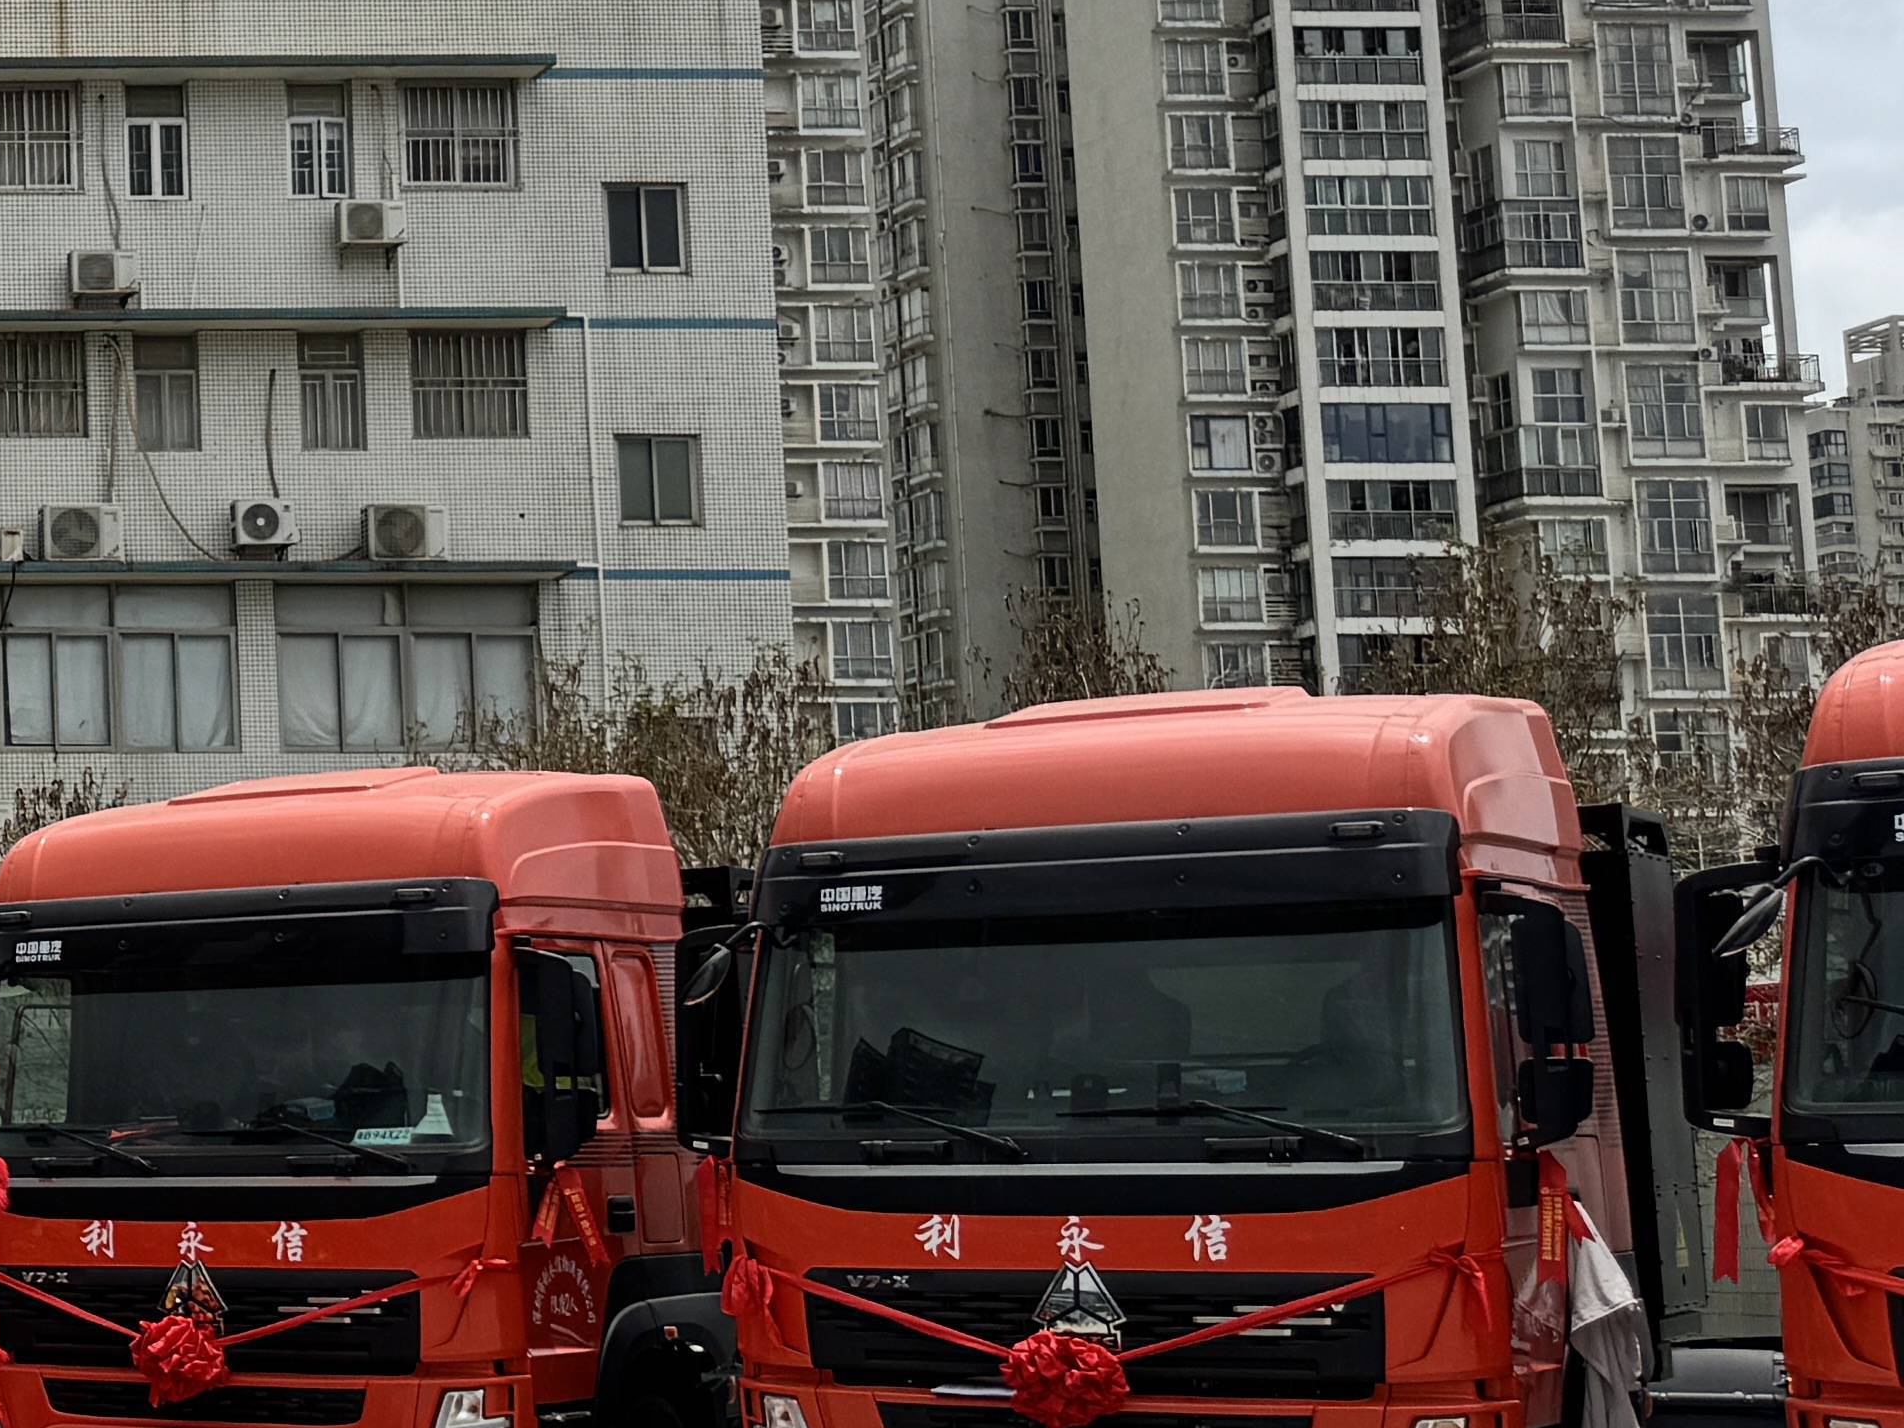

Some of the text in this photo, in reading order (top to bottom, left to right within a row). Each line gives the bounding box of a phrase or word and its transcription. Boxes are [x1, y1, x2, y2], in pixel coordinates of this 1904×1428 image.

[820, 901, 883, 912] SINOTRUK
[80, 1220, 308, 1262] 利永信
[914, 1215, 1231, 1262] 利永信
[21, 1271, 69, 1283] V7-X
[846, 1274, 910, 1289] V7-X
